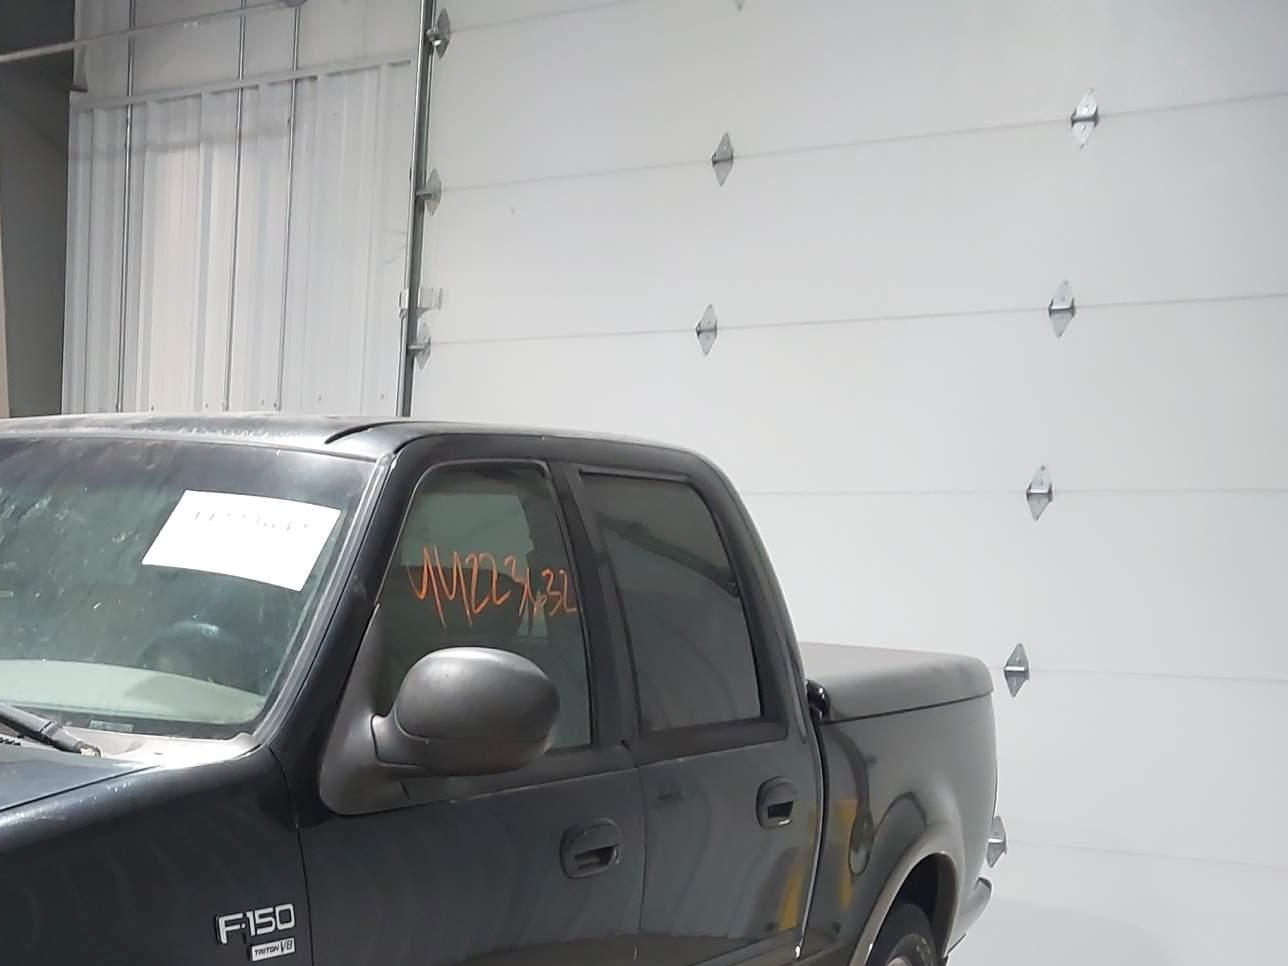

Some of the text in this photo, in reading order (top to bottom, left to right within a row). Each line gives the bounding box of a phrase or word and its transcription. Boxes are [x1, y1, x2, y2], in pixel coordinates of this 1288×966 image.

[217, 903, 296, 945] F-150
[254, 939, 293, 957] TRITON V8
